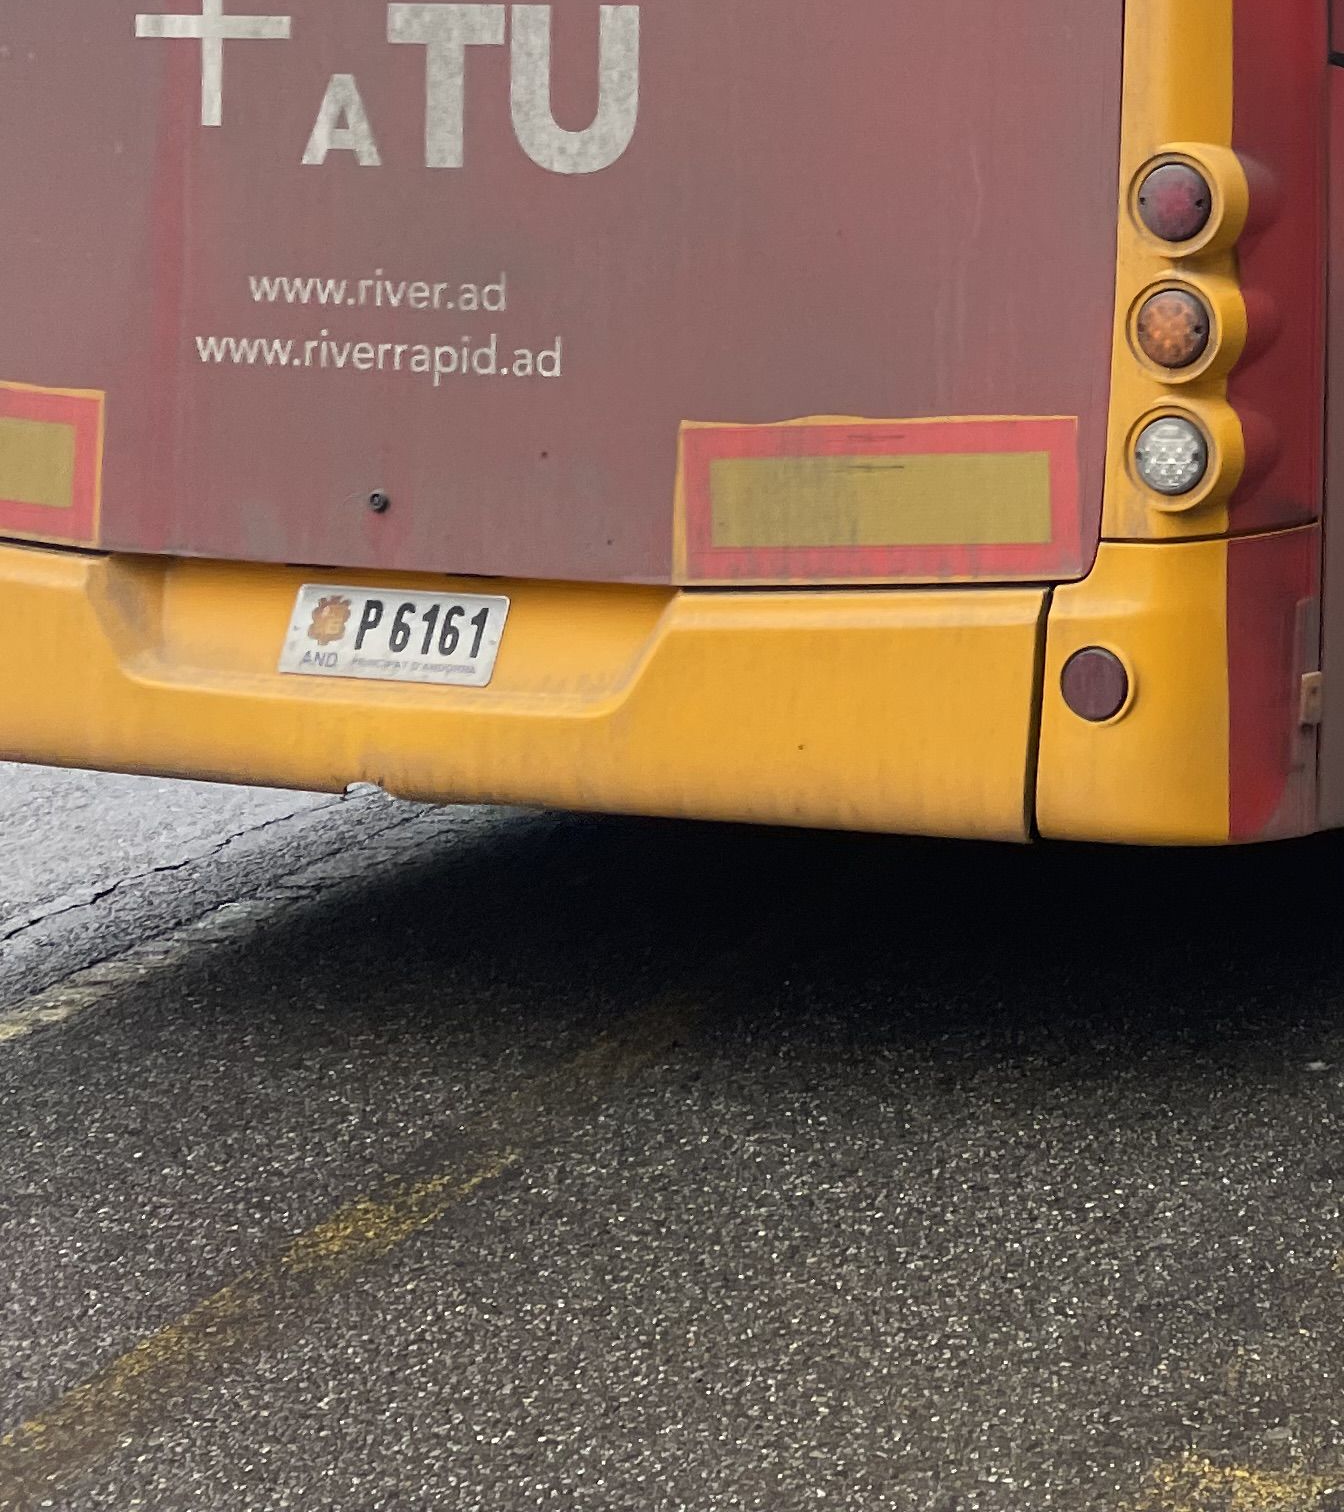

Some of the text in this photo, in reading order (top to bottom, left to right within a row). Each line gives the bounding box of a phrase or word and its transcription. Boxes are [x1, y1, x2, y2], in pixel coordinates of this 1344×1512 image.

[301, 2, 641, 175] A TU
[247, 268, 508, 312] www.river.ad
[195, 328, 562, 387] www.riverrapid.ad
[354, 599, 490, 659] P 6161
[302, 650, 339, 668] AND
